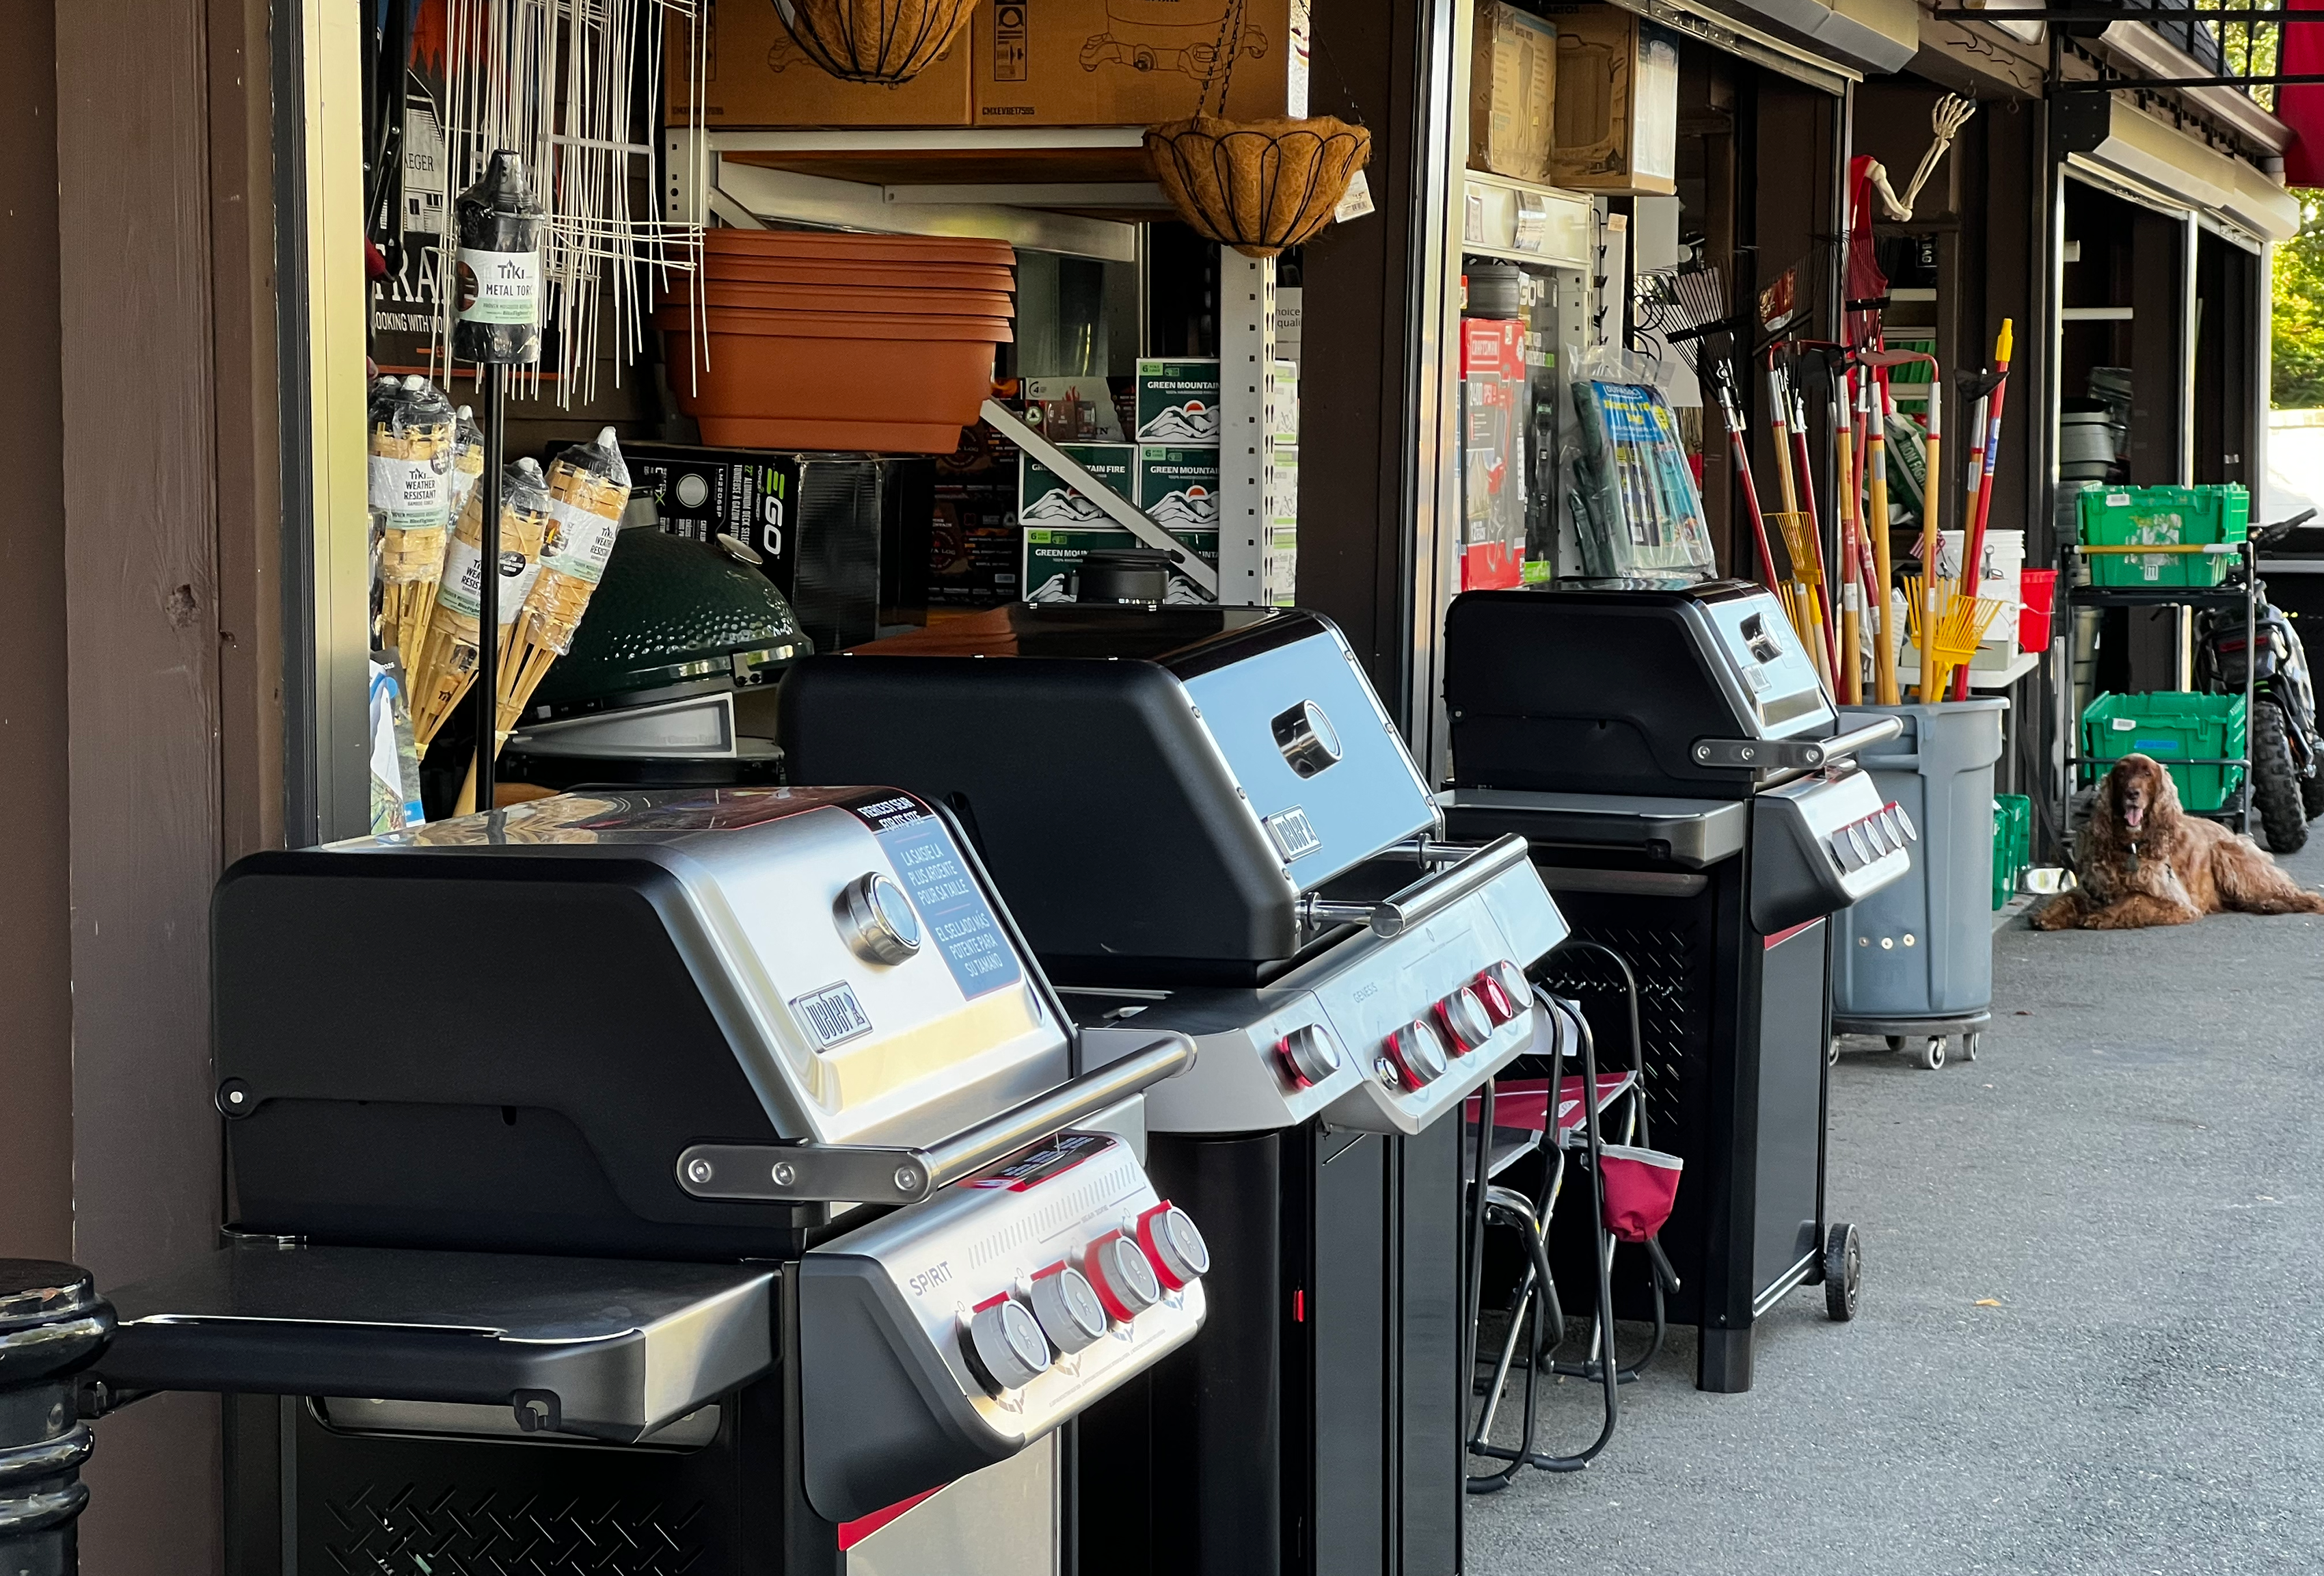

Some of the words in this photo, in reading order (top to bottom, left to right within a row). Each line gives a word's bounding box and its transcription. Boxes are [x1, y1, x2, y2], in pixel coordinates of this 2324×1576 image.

[486, 284, 513, 296] METAL
[1519, 278, 1537, 307] GO
[375, 311, 407, 332] OOKING
[407, 314, 429, 332] WITH
[1275, 308, 1301, 316] hoice
[1472, 340, 1498, 356] CRAFTSMAN
[1148, 381, 1176, 389] GREEN
[406, 479, 435, 490] WEATHER
[732, 464, 742, 494] TONDEUSE
[403, 490, 436, 500] RESISTANT
[743, 477, 753, 509] ALUMINUM
[742, 511, 751, 526] DECK
[764, 468, 785, 555] EGO
[1035, 549, 1064, 557] GREEN
[384, 661, 395, 670] 025
[900, 851, 915, 866] LA
[910, 845, 935, 864] SAISIE
[930, 842, 945, 858] LA
[908, 868, 929, 886] PLUS
[925, 860, 958, 881] ARDENTE
[917, 887, 941, 906] POUR
[935, 885, 949, 900] SA
[943, 879, 969, 898] TAILLE
[935, 926, 949, 942] EL
[944, 917, 977, 939] SELLADO
[972, 909, 990, 931] MÁS
[949, 937, 982, 960] POTENTE
[976, 932, 999, 951] PARA
[964, 960, 979, 978] SU
[973, 950, 1003, 974] TAMAÑO
[1353, 982, 1378, 1004] GENESIS
[805, 993, 854, 1040] weber
[909, 1261, 953, 1296] SPIRIT
